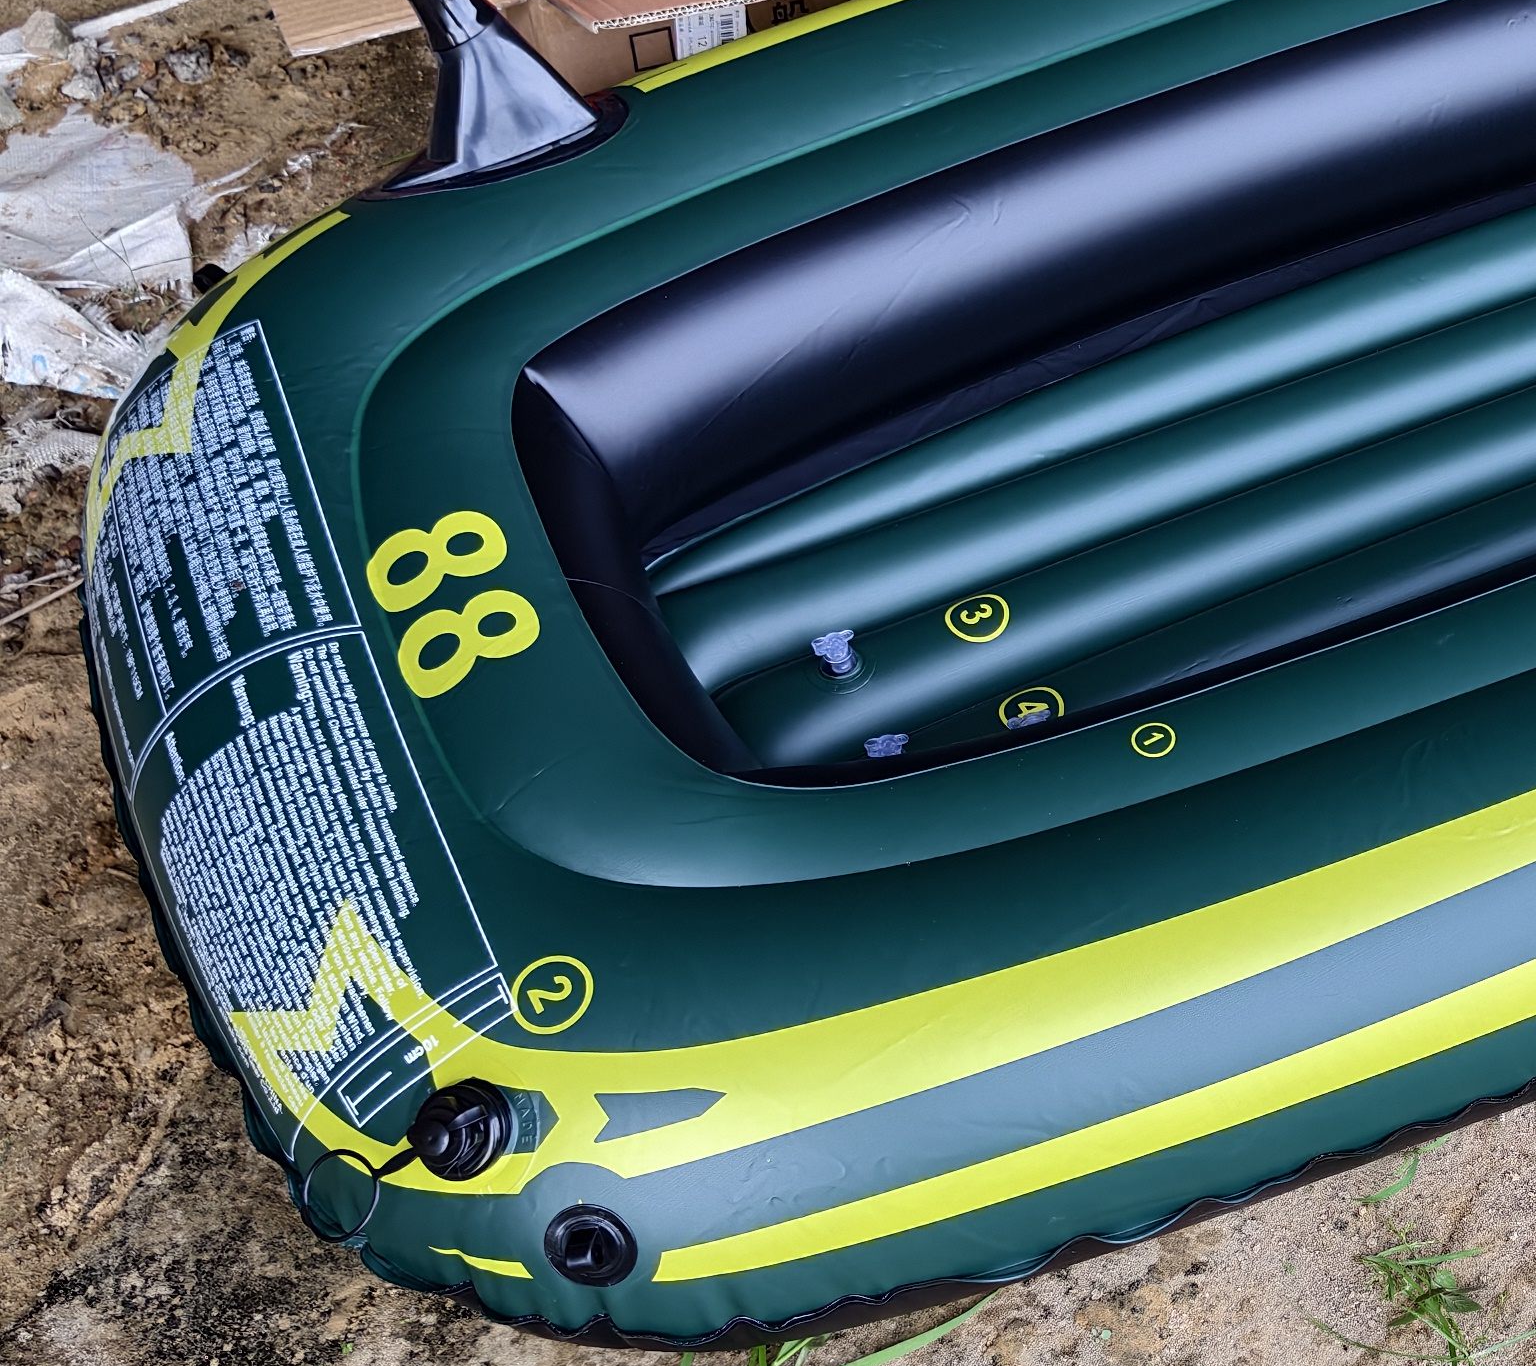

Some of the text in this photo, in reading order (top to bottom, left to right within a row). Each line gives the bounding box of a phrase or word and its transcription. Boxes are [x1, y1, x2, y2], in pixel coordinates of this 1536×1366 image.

[367, 511, 541, 699] 88
[302, 645, 316, 660] Do
[326, 639, 341, 655] Do
[306, 658, 321, 675] not
[331, 651, 346, 670] not
[283, 649, 314, 705] Warning:
[336, 667, 350, 685] use
[226, 673, 256, 729] Warnung:
[311, 672, 337, 720] overinflate!
[340, 681, 358, 704] high
[288, 704, 301, 715] A
[302, 699, 319, 720] This
[347, 701, 370, 740] pressure
[255, 719, 273, 746] these
[267, 714, 285, 741] Never
[278, 709, 300, 748] offshore
[289, 712, 314, 751] personal
[309, 717, 323, 729] is
[312, 726, 328, 744] not
[327, 716, 347, 746] Check
[245, 726, 262, 752] Nicht
[275, 738, 293, 764] allow
[317, 741, 329, 751] a
[337, 742, 352, 760] the
[363, 736, 376, 751] air
[253, 749, 265, 766] zur
[264, 744, 281, 768] rules
[291, 745, 309, 775] winds
[304, 747, 326, 784] flotation
[320, 747, 335, 765] life
[365, 748, 384, 775] pump
[214, 768, 228, 788] das
[272, 766, 285, 779] to
[281, 761, 302, 791] diving
[301, 773, 316, 794] and
[314, 642, 421, 909] The chambers should be inflated by adults in numbered sequence.
[323, 762, 345, 794] saving
[340, 757, 364, 791] printed
[376, 772, 389, 785] to
[208, 783, 222, 804] vom
[220, 785, 236, 810] Boot
[248, 774, 267, 805] Immer
[256, 763, 289, 828] Lebensrettung
[276, 776, 294, 803] avoid
[293, 788, 309, 808] into
[317, 781, 337, 812] device
[354, 787, 372, 812] ruler
[258, 802, 275, 826] eine
[300, 806, 315, 826] this
[327, 809, 340, 821] is
[335, 790, 357, 825] device.
[243, 826, 258, 845] Sie
[323, 832, 337, 848] Do
[329, 818, 354, 858] required
[347, 821, 364, 842] Use
[359, 808, 388, 856] frequently
[225, 835, 250, 878] Befolgen
[249, 842, 272, 881] niemals
[266, 823, 302, 895] Schwimmweste
[328, 846, 343, 864] not
[345, 855, 360, 872] for
[352, 840, 371, 863] only
[300, 845, 327, 891] paralysis
[320, 860, 339, 890] Never
[334, 862, 348, 882] use
[362, 860, 382, 890] under
[378, 852, 398, 880] while
[243, 875, 257, 893] Sie
[263, 878, 279, 900] das
[341, 880, 354, 893] in
[351, 869, 369, 894] each
[223, 740, 248, 785] schnellen
[260, 840, 284, 881] offenem
[275, 878, 298, 917] Wasser
[289, 915, 308, 940] oder
[329, 1003, 358, 1052] Gezeiten
[249, 891, 267, 919] diese
[258, 888, 278, 923] lassen
[303, 883, 322, 910] unter
[319, 888, 330, 901] or
[331, 888, 346, 908] tow
[343, 890, 363, 915] high
[270, 896, 296, 939] Tauchen
[323, 900, 341, 927] other
[370, 887, 401, 940] competent
[271, 921, 285, 940] Sie
[307, 926, 327, 956] Nicht
[346, 930, 362, 950] any
[278, 939, 290, 954] es
[287, 937, 303, 957] mit
[334, 927, 357, 966] serious
[363, 940, 382, 966] open
[275, 954, 288, 972] um
[331, 949, 345, 970] von
[284, 952, 309, 994] niemals
[395, 976, 408, 989] of
[339, 968, 377, 1036] Erwachsenen
[373, 986, 396, 1022] Follow
[328, 1044, 343, 1063] der
[403, 1035, 440, 1065] 10cm
